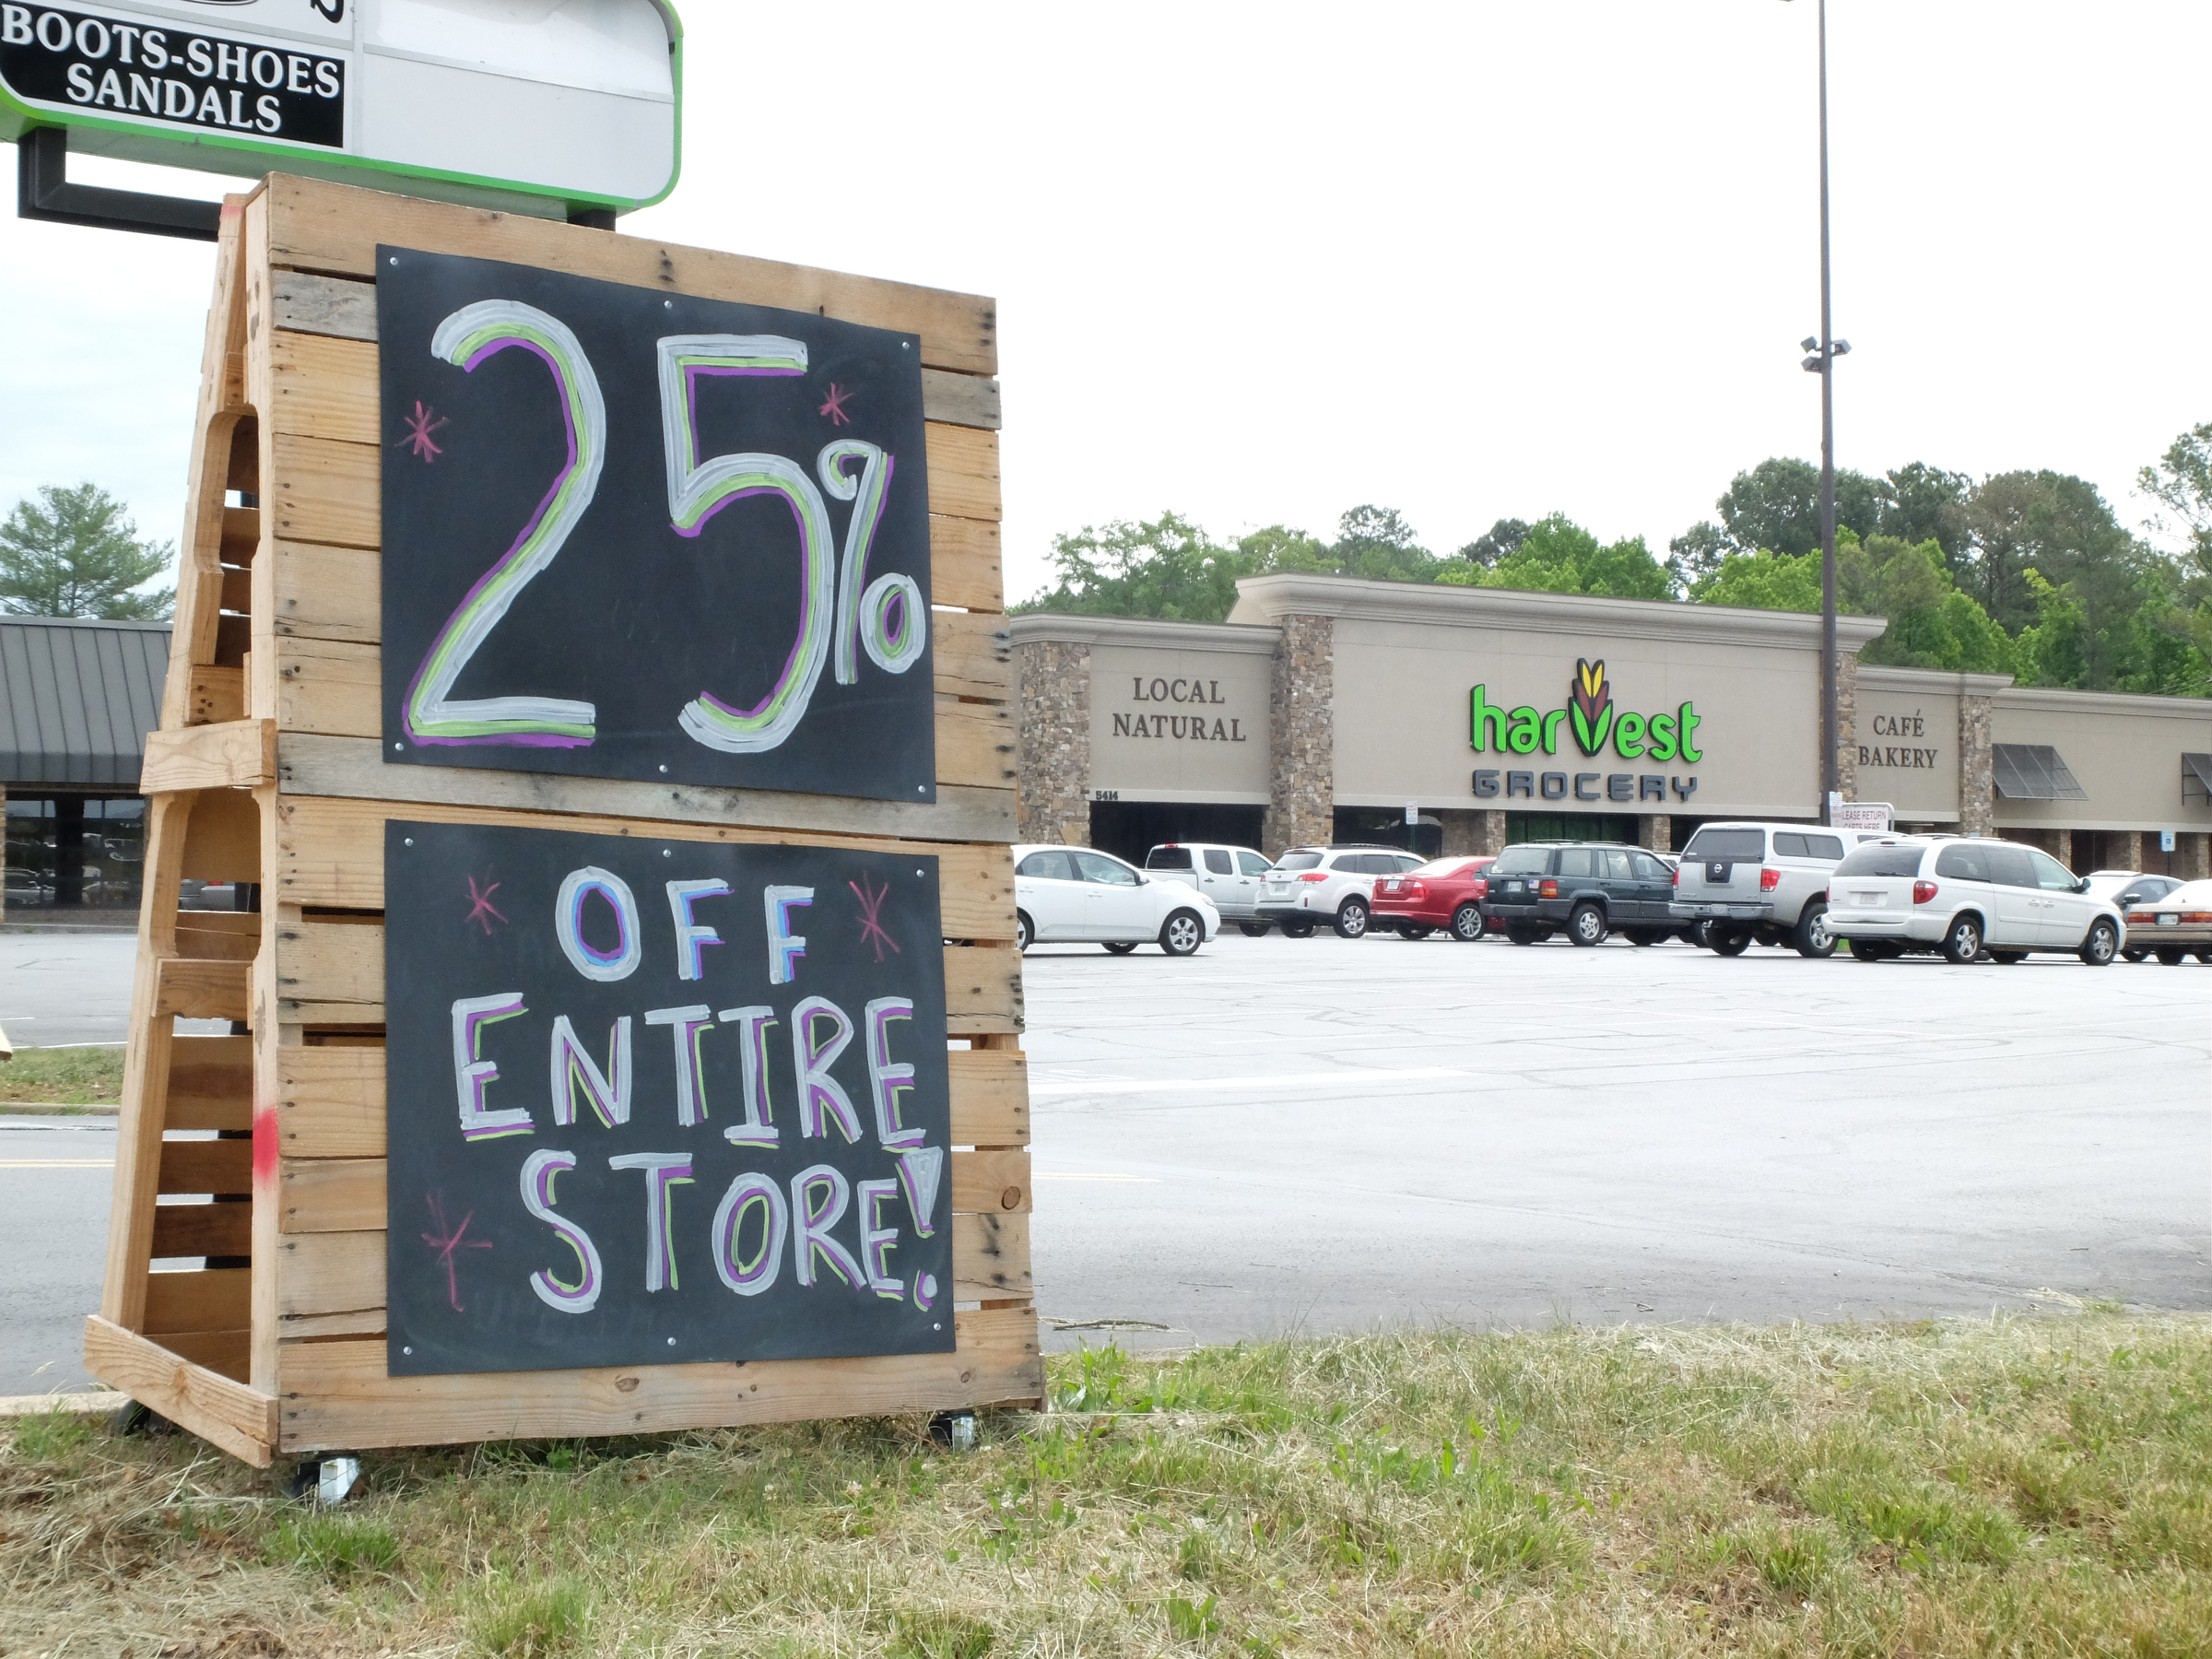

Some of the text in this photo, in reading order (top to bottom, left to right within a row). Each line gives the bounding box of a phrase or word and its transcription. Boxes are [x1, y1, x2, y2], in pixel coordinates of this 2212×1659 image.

[1, 4, 339, 98] BOOTS-SHOES
[65, 63, 281, 133] SANDALS
[403, 299, 926, 753] 25%
[1133, 677, 1225, 704] LOCAL
[1112, 713, 1247, 742] NATURAL
[1873, 709, 1924, 737] CAFÉ
[1858, 746, 1938, 769] BAKERY
[1096, 790, 1118, 800] 5414
[1472, 770, 1698, 801] GROCERY
[1841, 810, 1861, 820] LEASE
[1862, 810, 1887, 820] RETURN
[555, 865, 815, 984] OFF
[452, 992, 926, 1152] ENTIRE
[520, 1147, 943, 1313] STORE!
